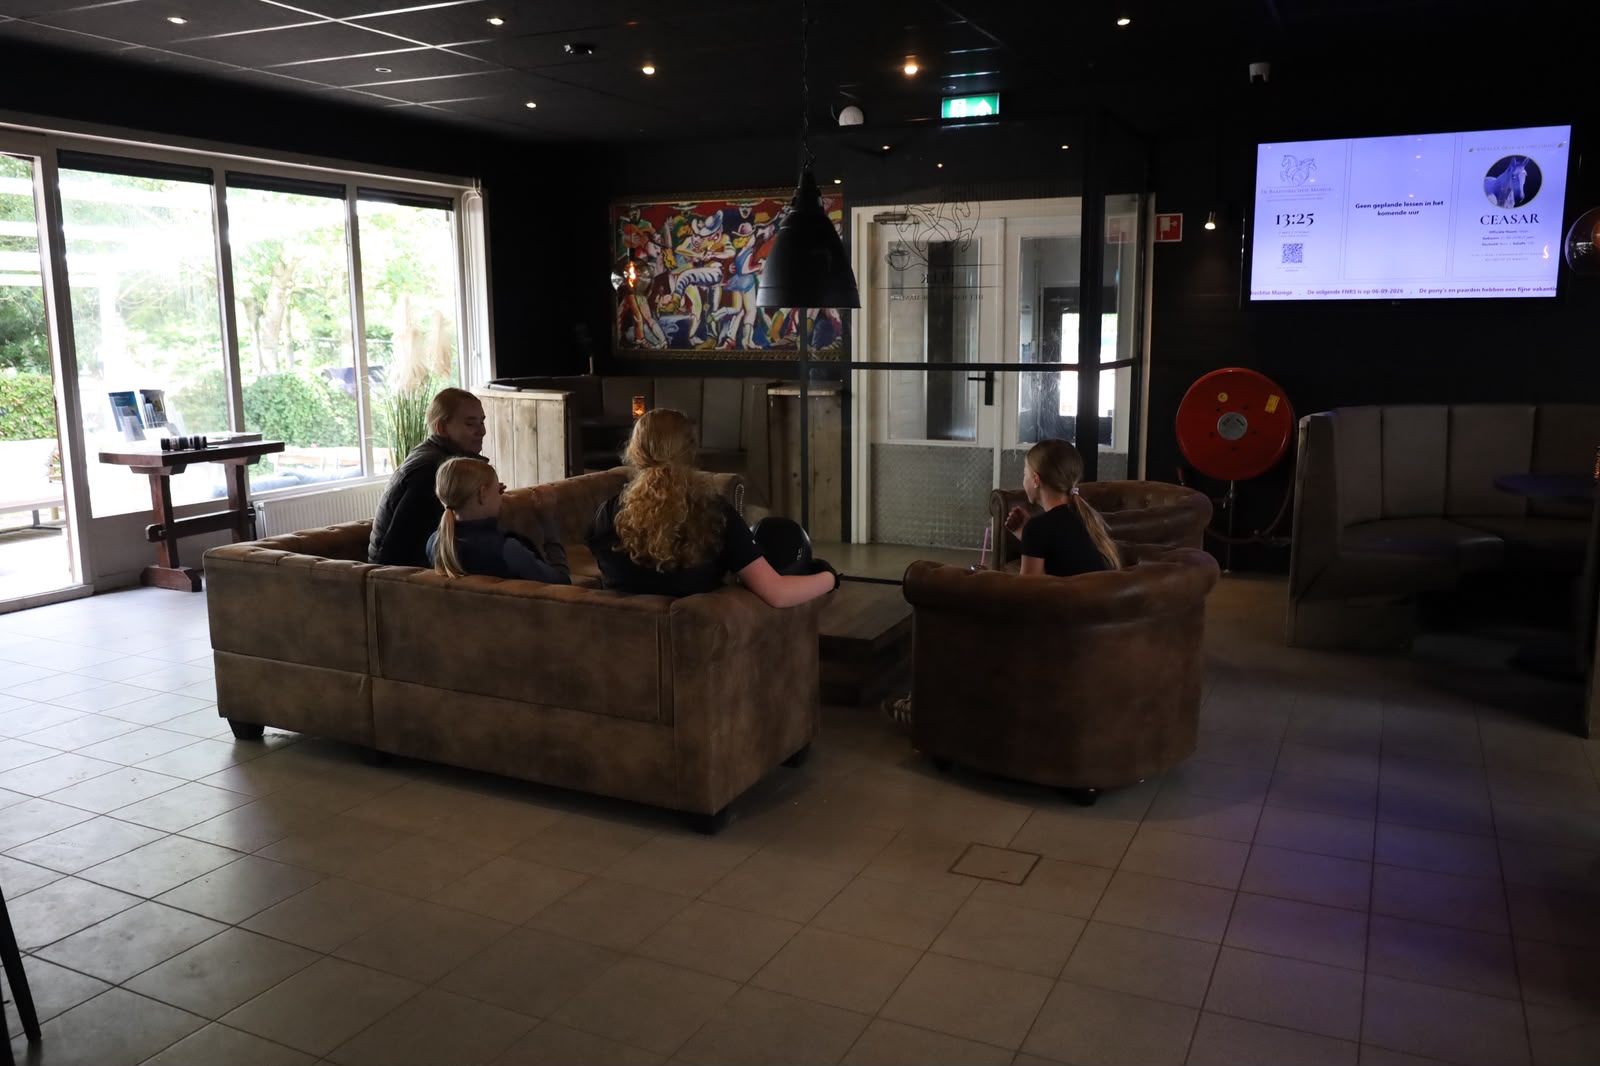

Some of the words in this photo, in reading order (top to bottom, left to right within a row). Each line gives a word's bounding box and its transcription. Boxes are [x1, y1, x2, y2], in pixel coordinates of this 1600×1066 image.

[1373, 202, 1402, 210] geplande
[1275, 213, 1315, 228] 13:25
[1479, 213, 1541, 226] CEASAR
